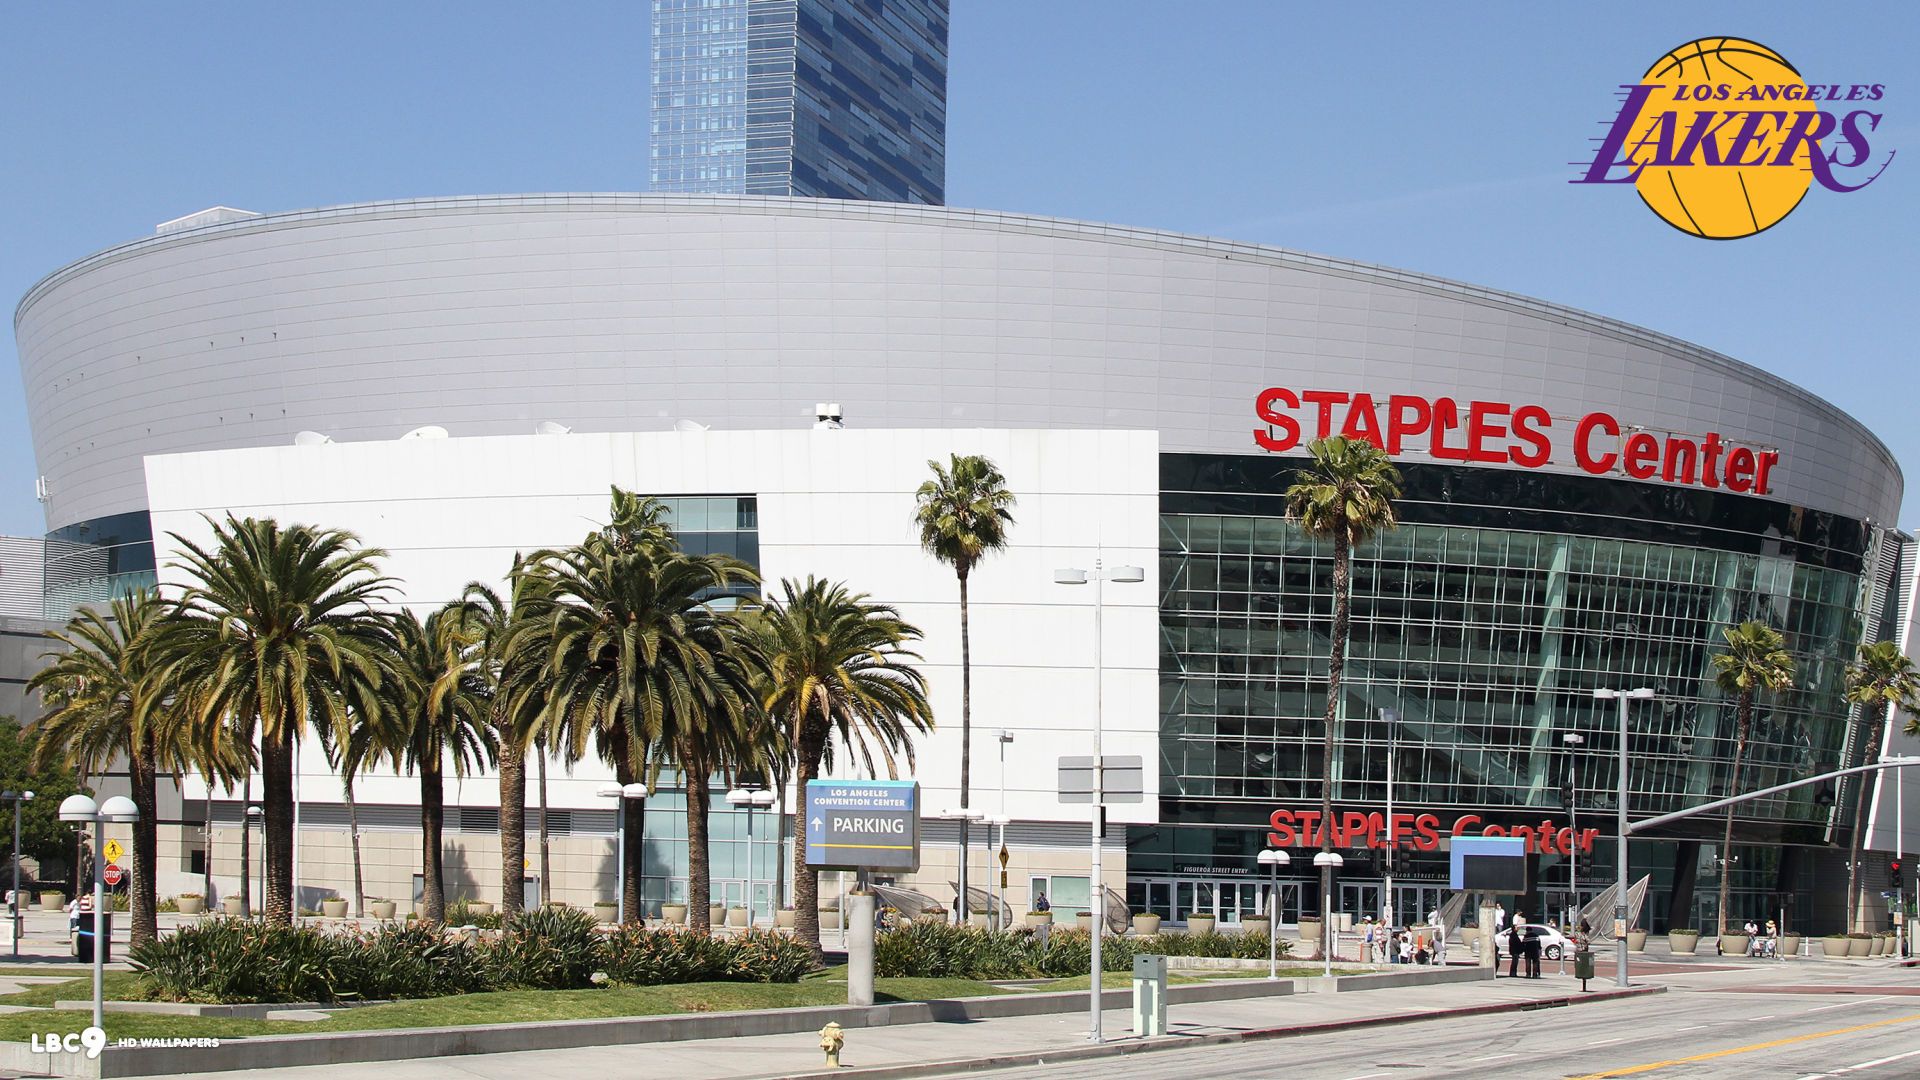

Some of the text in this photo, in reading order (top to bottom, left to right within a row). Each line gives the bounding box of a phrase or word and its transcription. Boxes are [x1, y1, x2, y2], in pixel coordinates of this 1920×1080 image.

[1252, 387, 1780, 495] STAPLES Center
[831, 789, 847, 797] LOS
[814, 798, 905, 807] CONVENTION CENTER
[833, 817, 904, 834] PARKING
[105, 870, 120, 878] STOP
